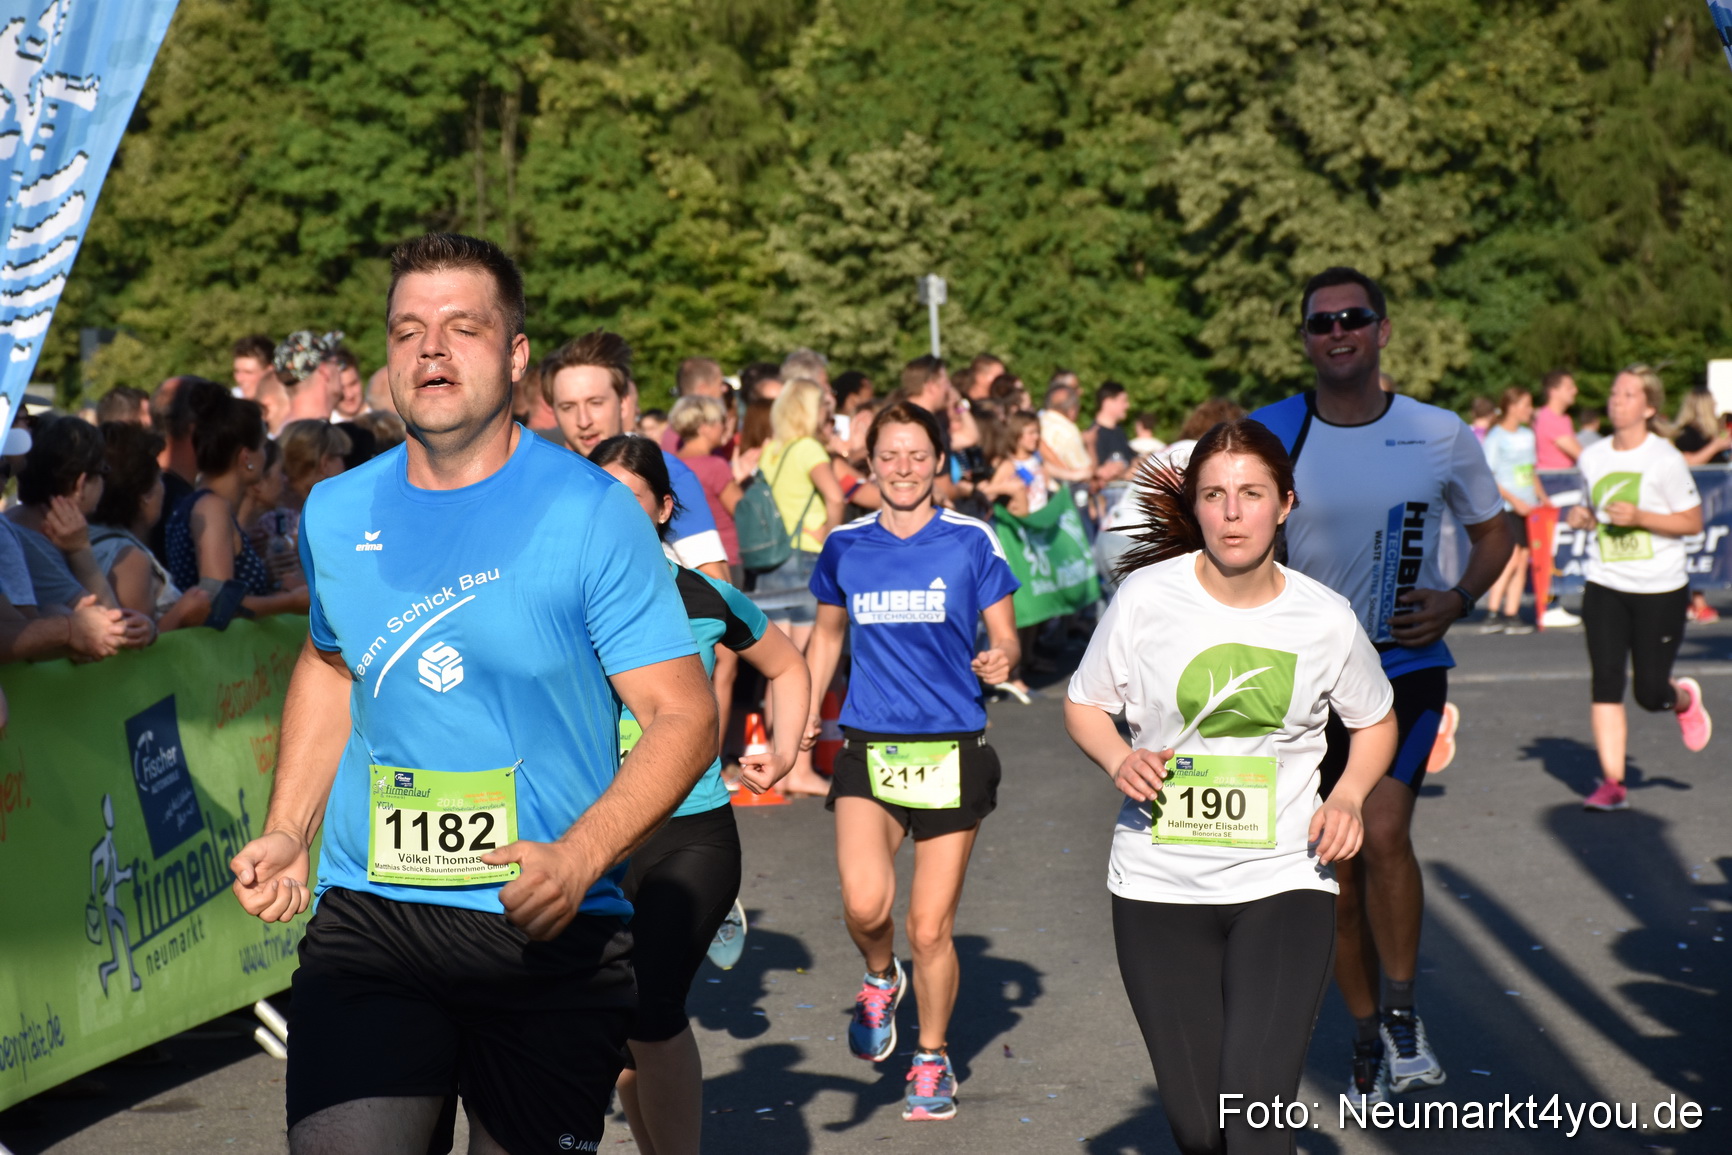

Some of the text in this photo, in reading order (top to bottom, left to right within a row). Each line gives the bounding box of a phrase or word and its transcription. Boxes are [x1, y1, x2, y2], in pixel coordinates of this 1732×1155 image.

[355, 542, 383, 551] erima
[1373, 530, 1383, 562] WASTE
[1380, 529, 1400, 633] TECHNOLOGY
[386, 586, 457, 634] Schick
[458, 567, 501, 591] Bau
[852, 589, 946, 613] HUBER
[871, 612, 942, 621] TECHNOLOGY
[142, 745, 177, 783] Fischer
[879, 766, 943, 790] 211
[1213, 776, 1236, 784] 2018
[385, 784, 431, 799] firmenlauf
[436, 798, 464, 808] 2018
[1179, 787, 1247, 821] 190
[386, 809, 496, 853] 1182
[1167, 820, 1259, 831] Hallmeyer Elisabeth
[132, 787, 253, 940] firmenlauf
[374, 862, 401, 871] Matthias
[401, 865, 424, 873] Schick
[398, 852, 482, 865] Völkel Thomas
[145, 916, 206, 976] neumarkt
